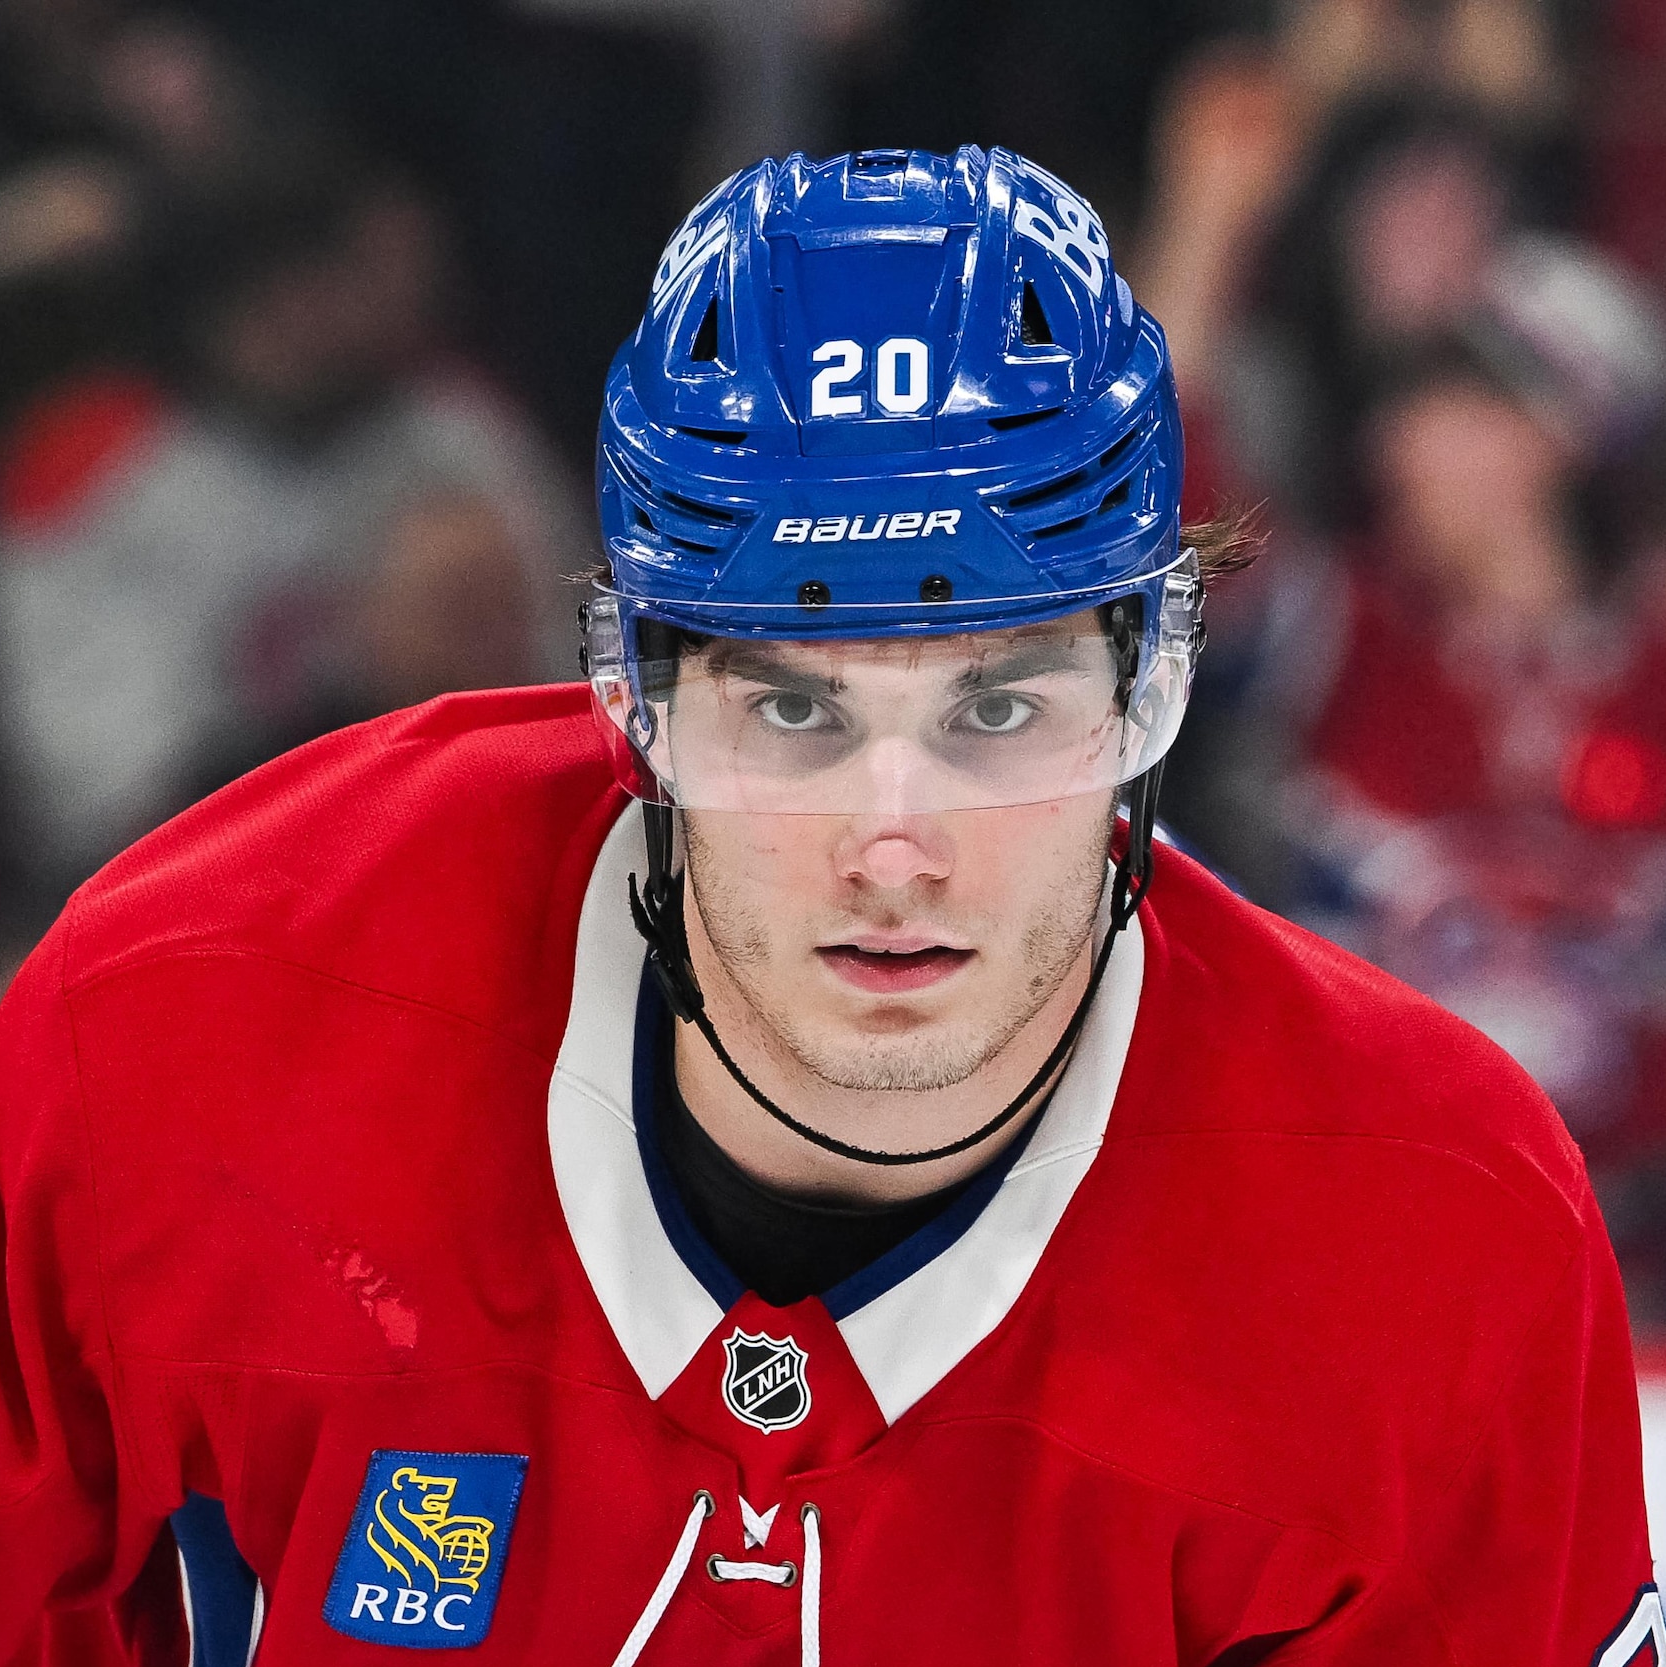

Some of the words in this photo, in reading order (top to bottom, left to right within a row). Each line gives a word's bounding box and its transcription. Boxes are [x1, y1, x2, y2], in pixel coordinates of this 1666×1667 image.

[811, 338, 930, 418] 20
[741, 1355, 793, 1404] LNH
[349, 1582, 473, 1632] RBC
